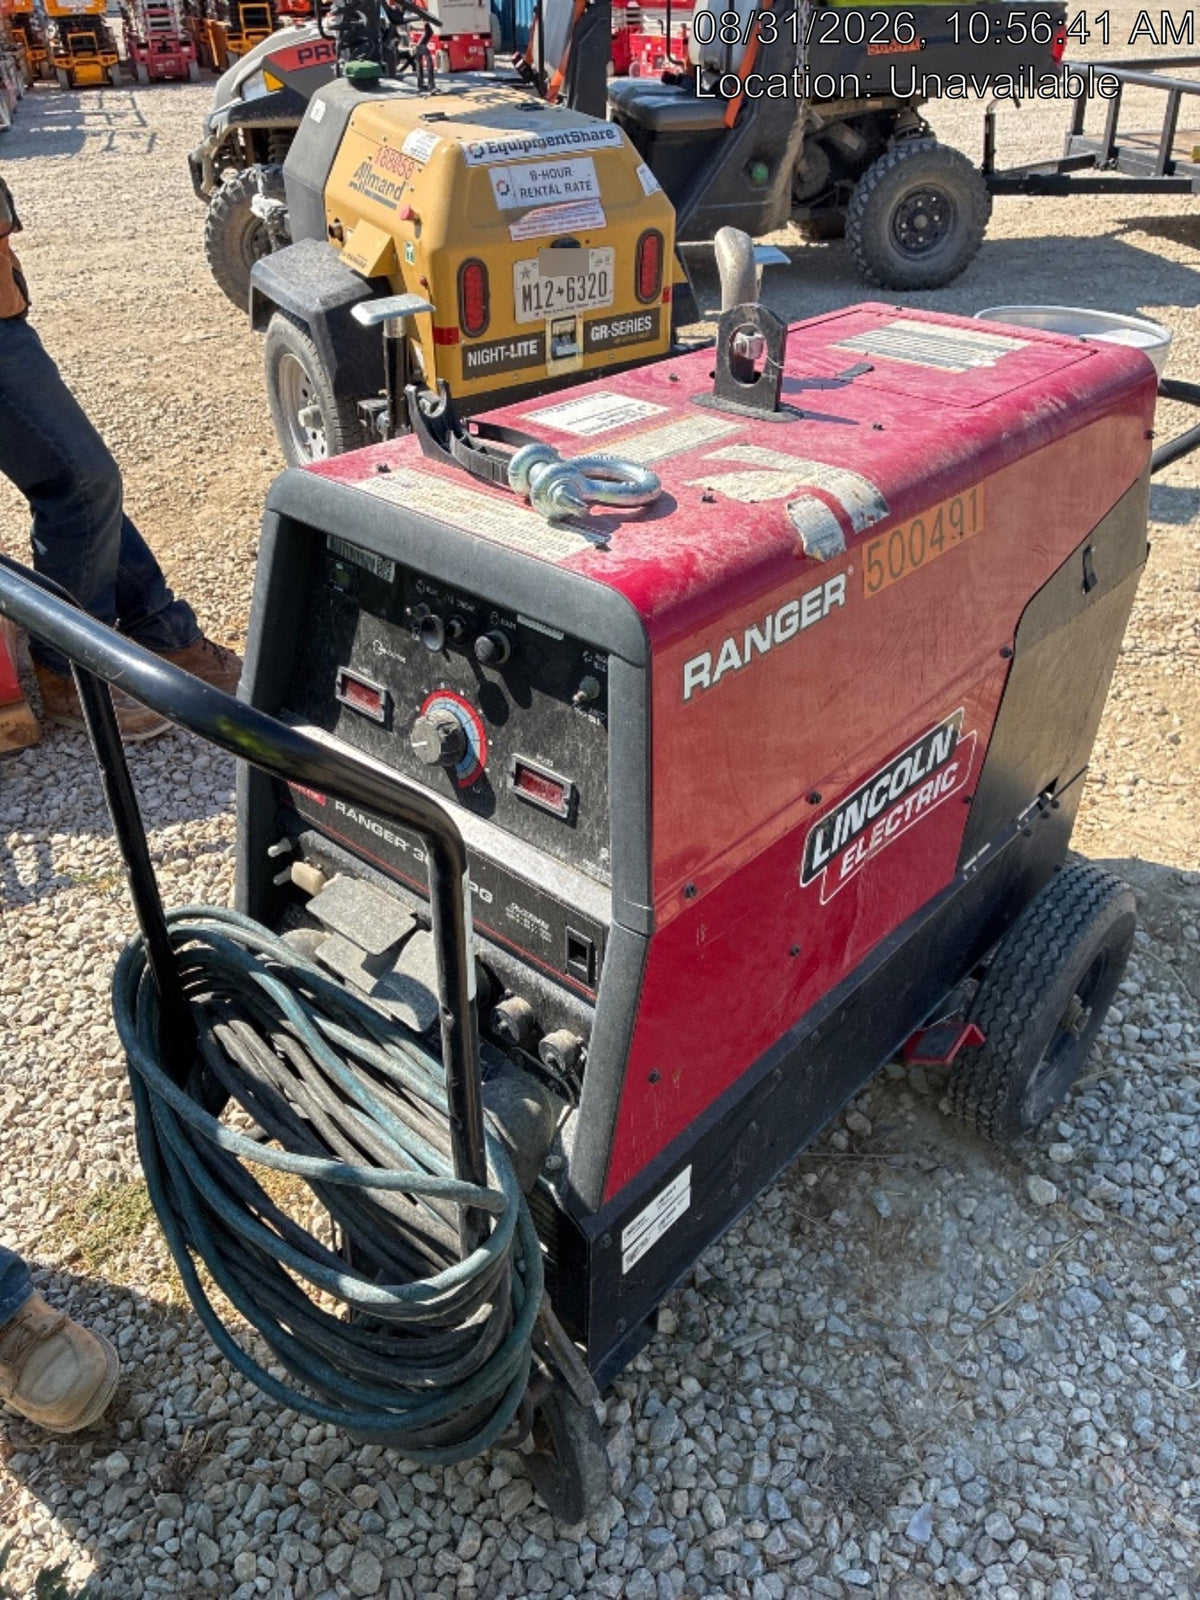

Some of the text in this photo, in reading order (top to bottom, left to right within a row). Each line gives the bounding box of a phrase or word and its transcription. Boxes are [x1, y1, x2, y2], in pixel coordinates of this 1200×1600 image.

[487, 128, 617, 154] EquipmentShare
[353, 160, 406, 201] Allmand
[519, 181, 593, 198] RENTAL RATE
[528, 166, 574, 181] 8-HOUR
[566, 271, 607, 303] 6320
[591, 316, 652, 341] GR-SERIES
[467, 340, 538, 367] NIGHT-LITE
[865, 488, 978, 593] 500491
[682, 572, 847, 701] RANGER
[812, 723, 954, 870] LINCOLN
[335, 801, 409, 852] RANGER
[838, 762, 959, 881] ELECTRIC
